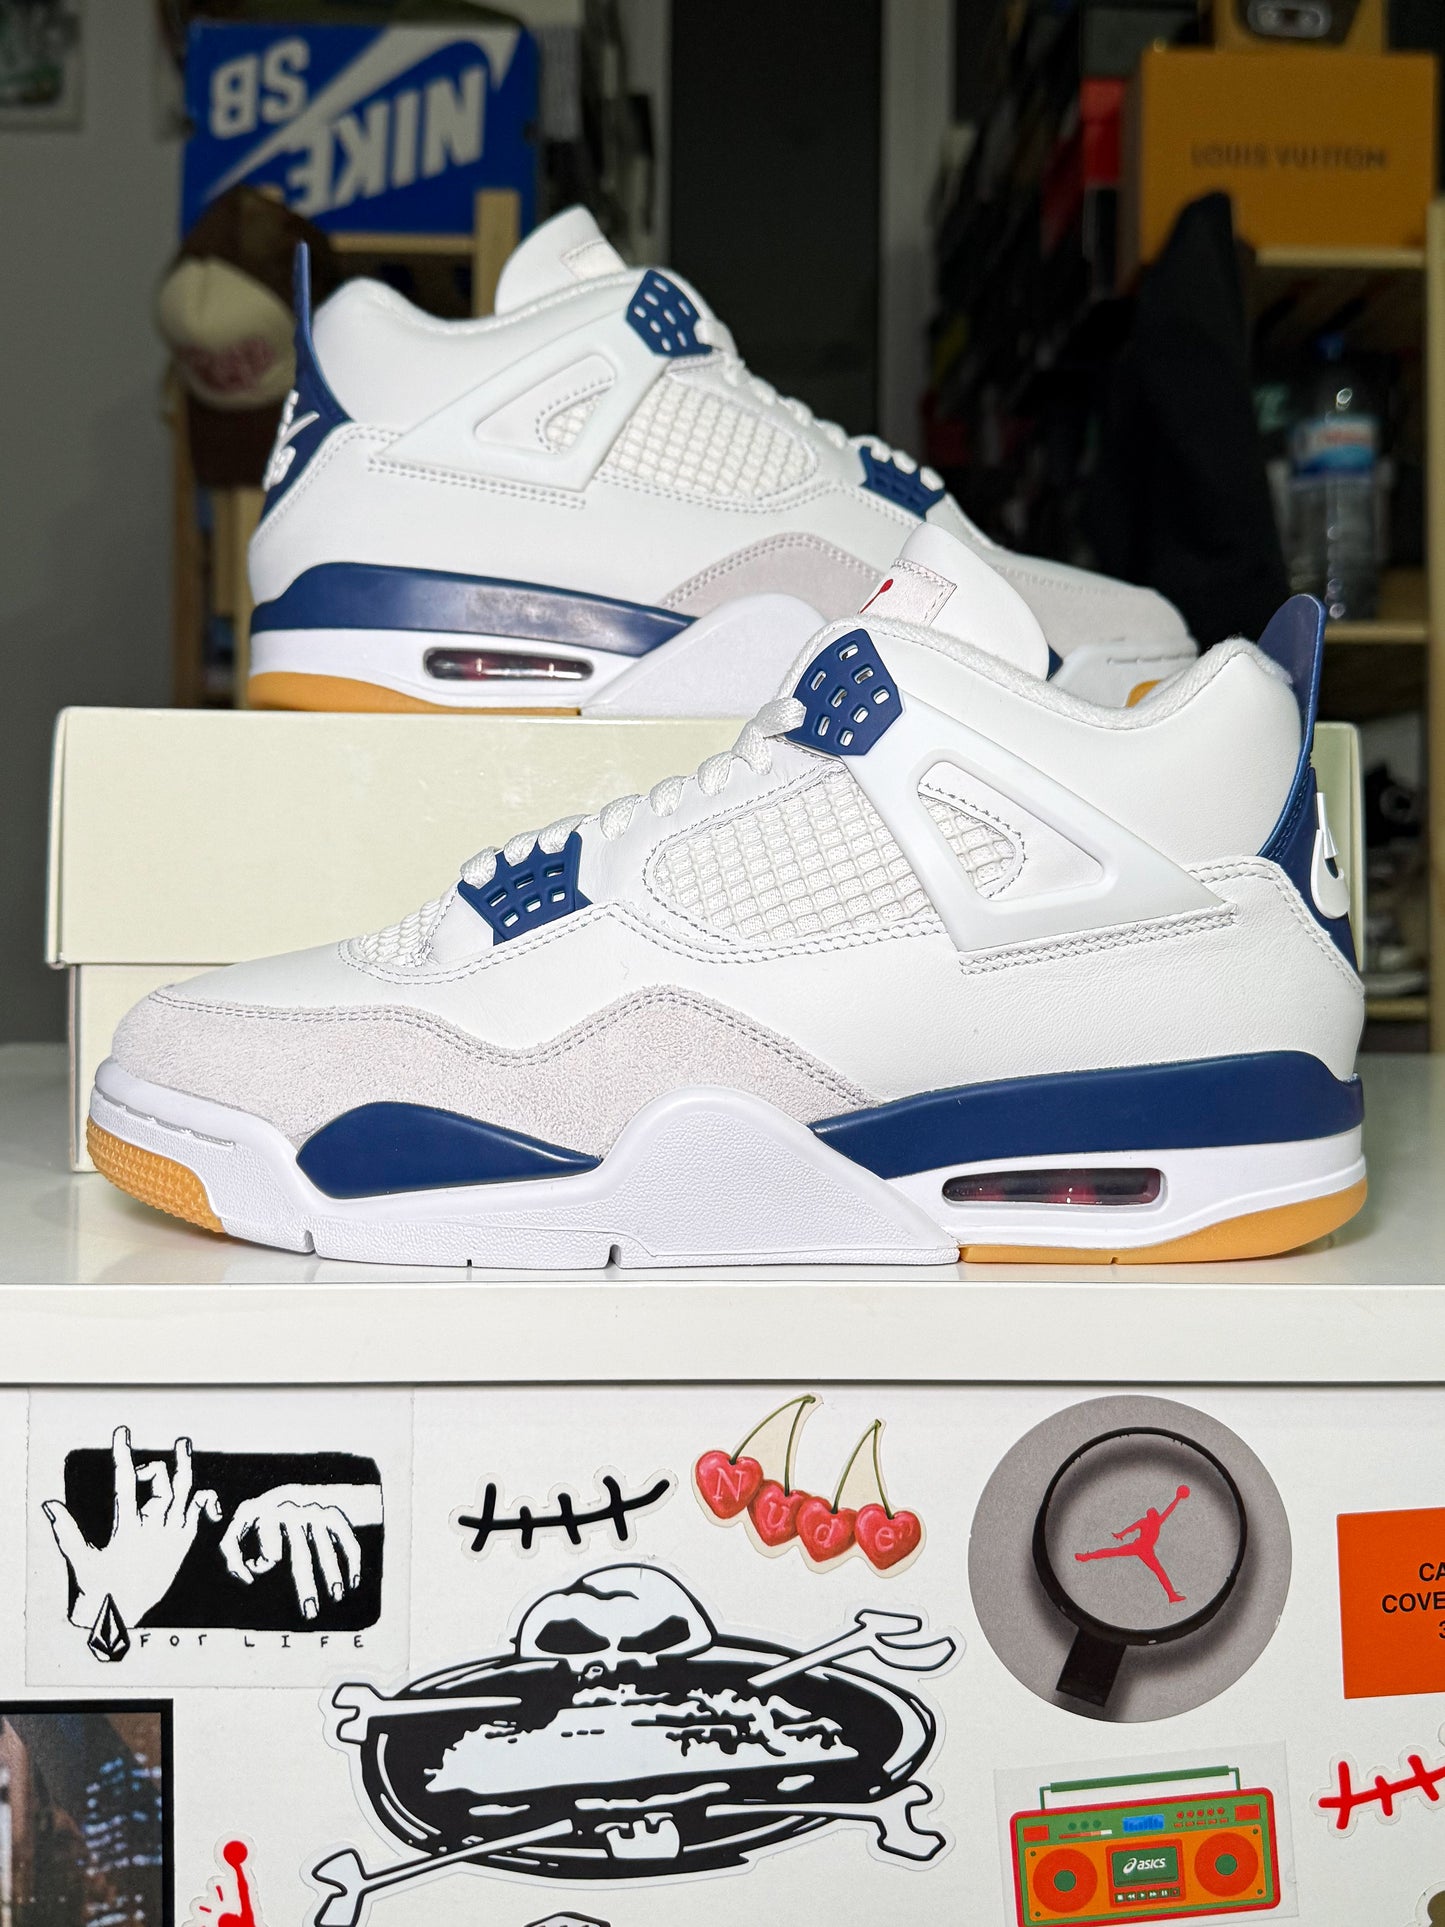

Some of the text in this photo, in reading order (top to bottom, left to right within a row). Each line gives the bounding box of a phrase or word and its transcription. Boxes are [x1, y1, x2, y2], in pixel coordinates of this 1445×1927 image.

[209, 38, 310, 140] SB
[286, 64, 487, 218] NIKE
[1191, 144, 1388, 169] LOUIS VUITTON
[243, 1634, 364, 1649] LIFE
